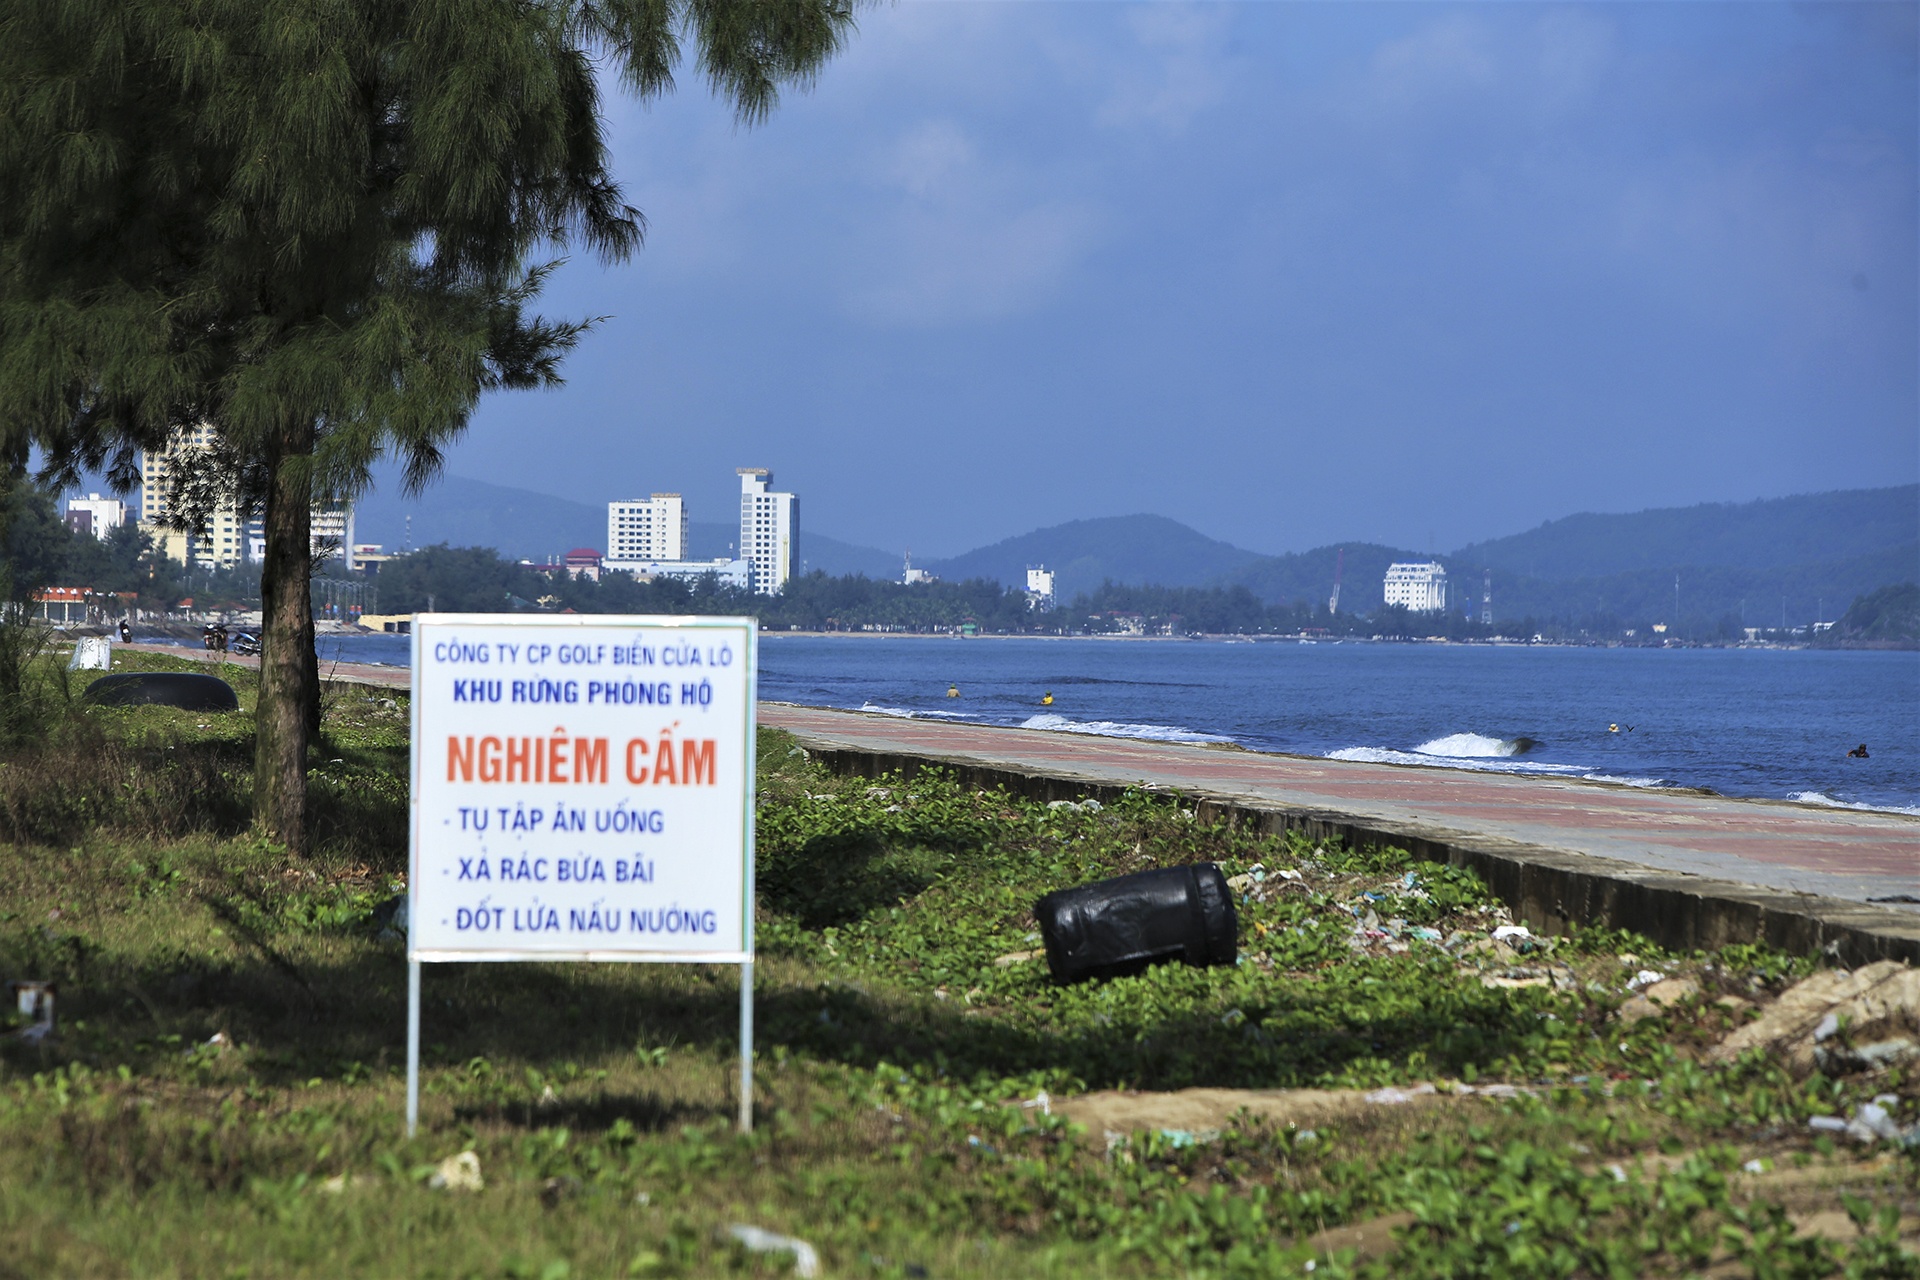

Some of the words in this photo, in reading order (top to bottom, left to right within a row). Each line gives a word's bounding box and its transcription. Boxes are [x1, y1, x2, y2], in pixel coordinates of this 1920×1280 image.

[434, 636, 490, 664] CÔNG
[496, 644, 520, 664] TY
[527, 645, 551, 664] CP
[558, 645, 606, 664] GOLF
[613, 634, 656, 666] BIỂN
[662, 638, 702, 666] CỬA
[453, 679, 502, 702] KHU
[511, 673, 578, 704] RỪNG
[588, 676, 671, 705] PHÒNG
[682, 676, 712, 712] HỘ
[446, 726, 610, 784] NGHIÊM
[625, 720, 717, 786] CẤM
[458, 808, 489, 840] TỤ
[497, 802, 544, 841] TẬP
[552, 802, 586, 832] ĂN
[595, 798, 664, 834] UỐNG
[458, 846, 491, 881] XẢ
[500, 851, 548, 881] RÁC
[558, 852, 606, 882] BỪA
[616, 852, 654, 882] BÃI
[456, 895, 505, 931] ĐỐT
[514, 896, 560, 932] LỬA
[570, 898, 621, 932] NẤU
[630, 902, 717, 934] NƯỚNG
